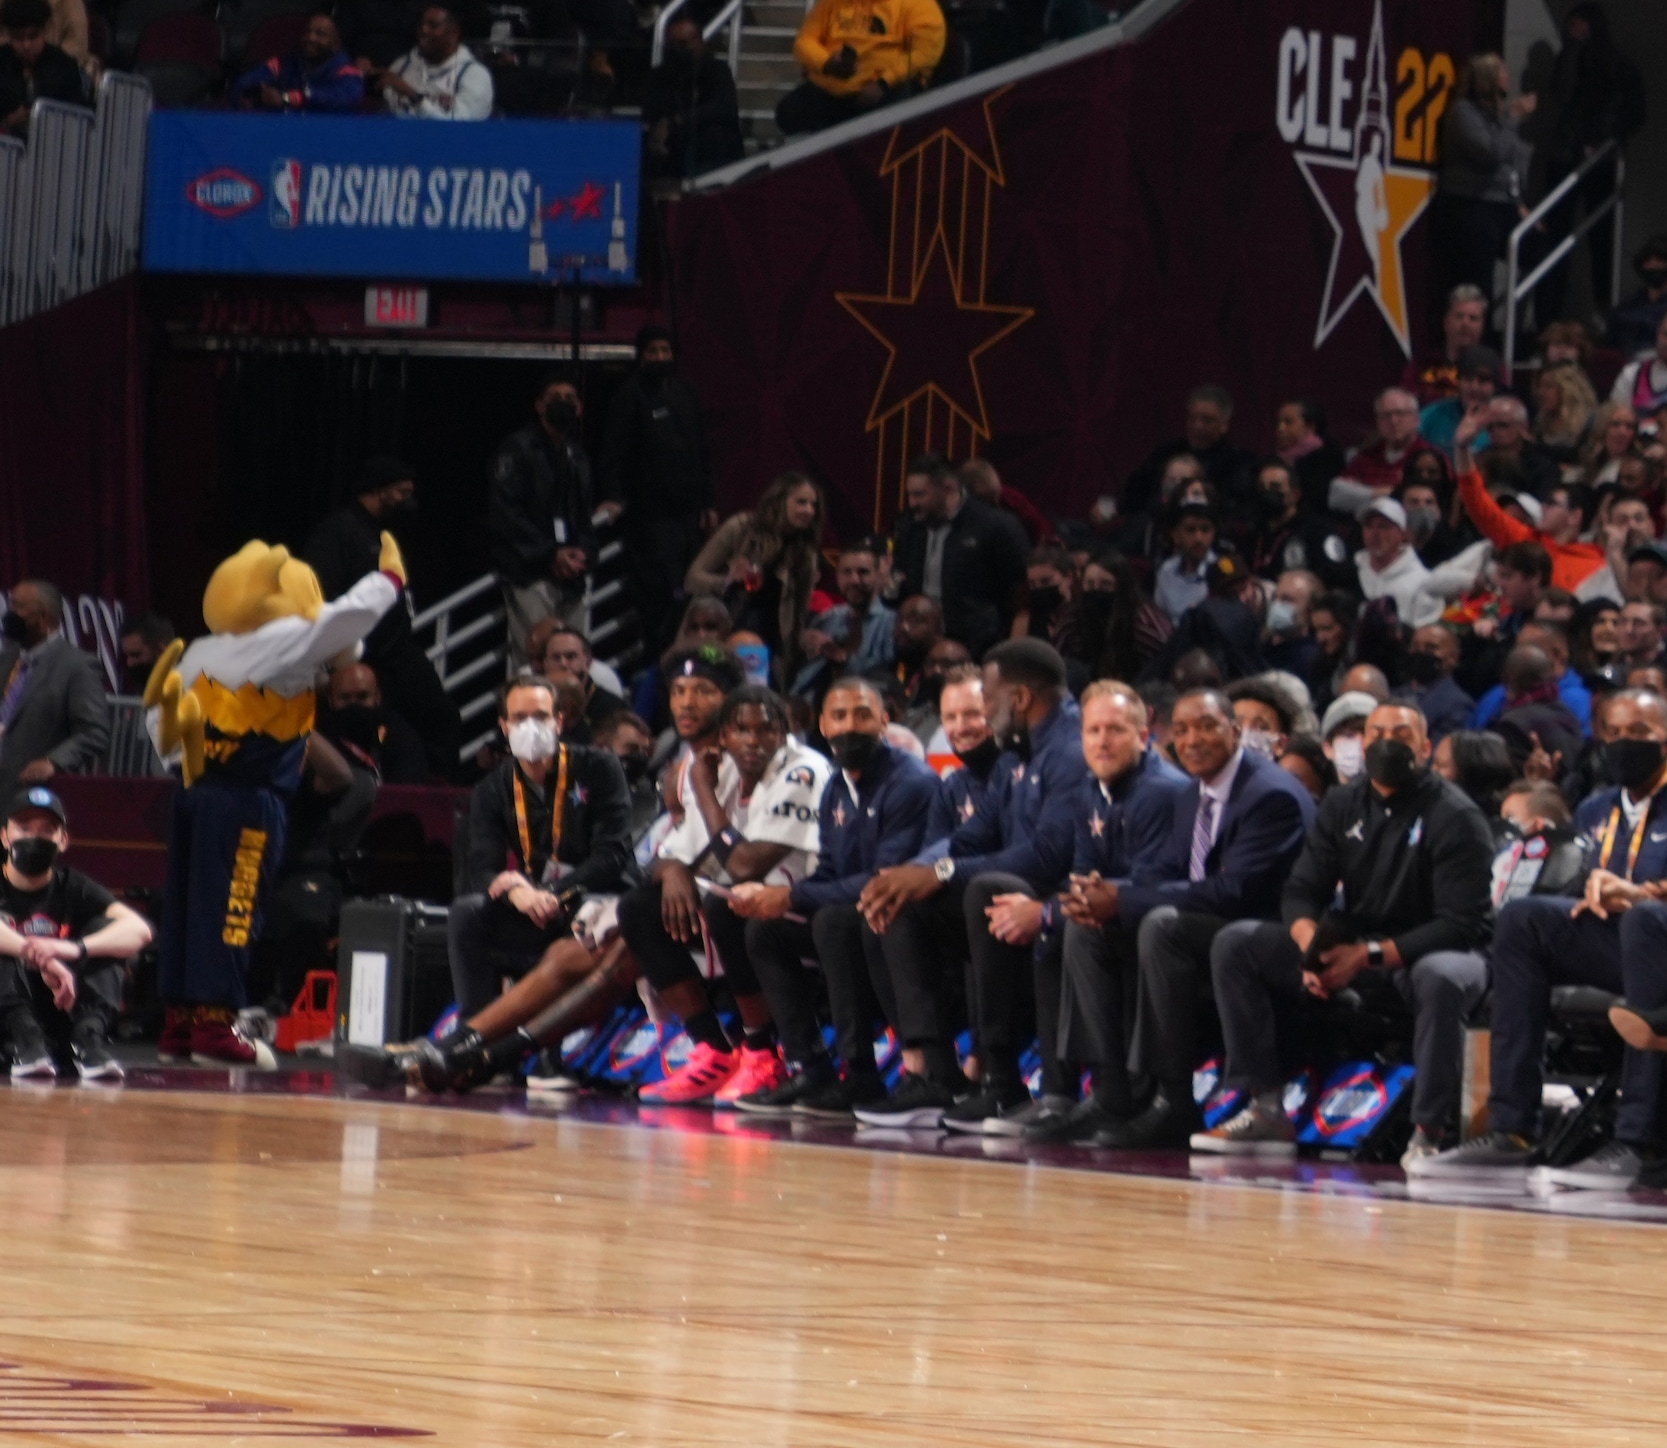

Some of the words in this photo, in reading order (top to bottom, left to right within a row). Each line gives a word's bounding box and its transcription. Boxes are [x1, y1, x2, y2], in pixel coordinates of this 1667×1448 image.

[1275, 26, 1357, 152] CLE
[1394, 46, 1457, 164] 22
[304, 163, 422, 228] RISING
[422, 165, 532, 232] STARS
[376, 283, 417, 322] EXIT
